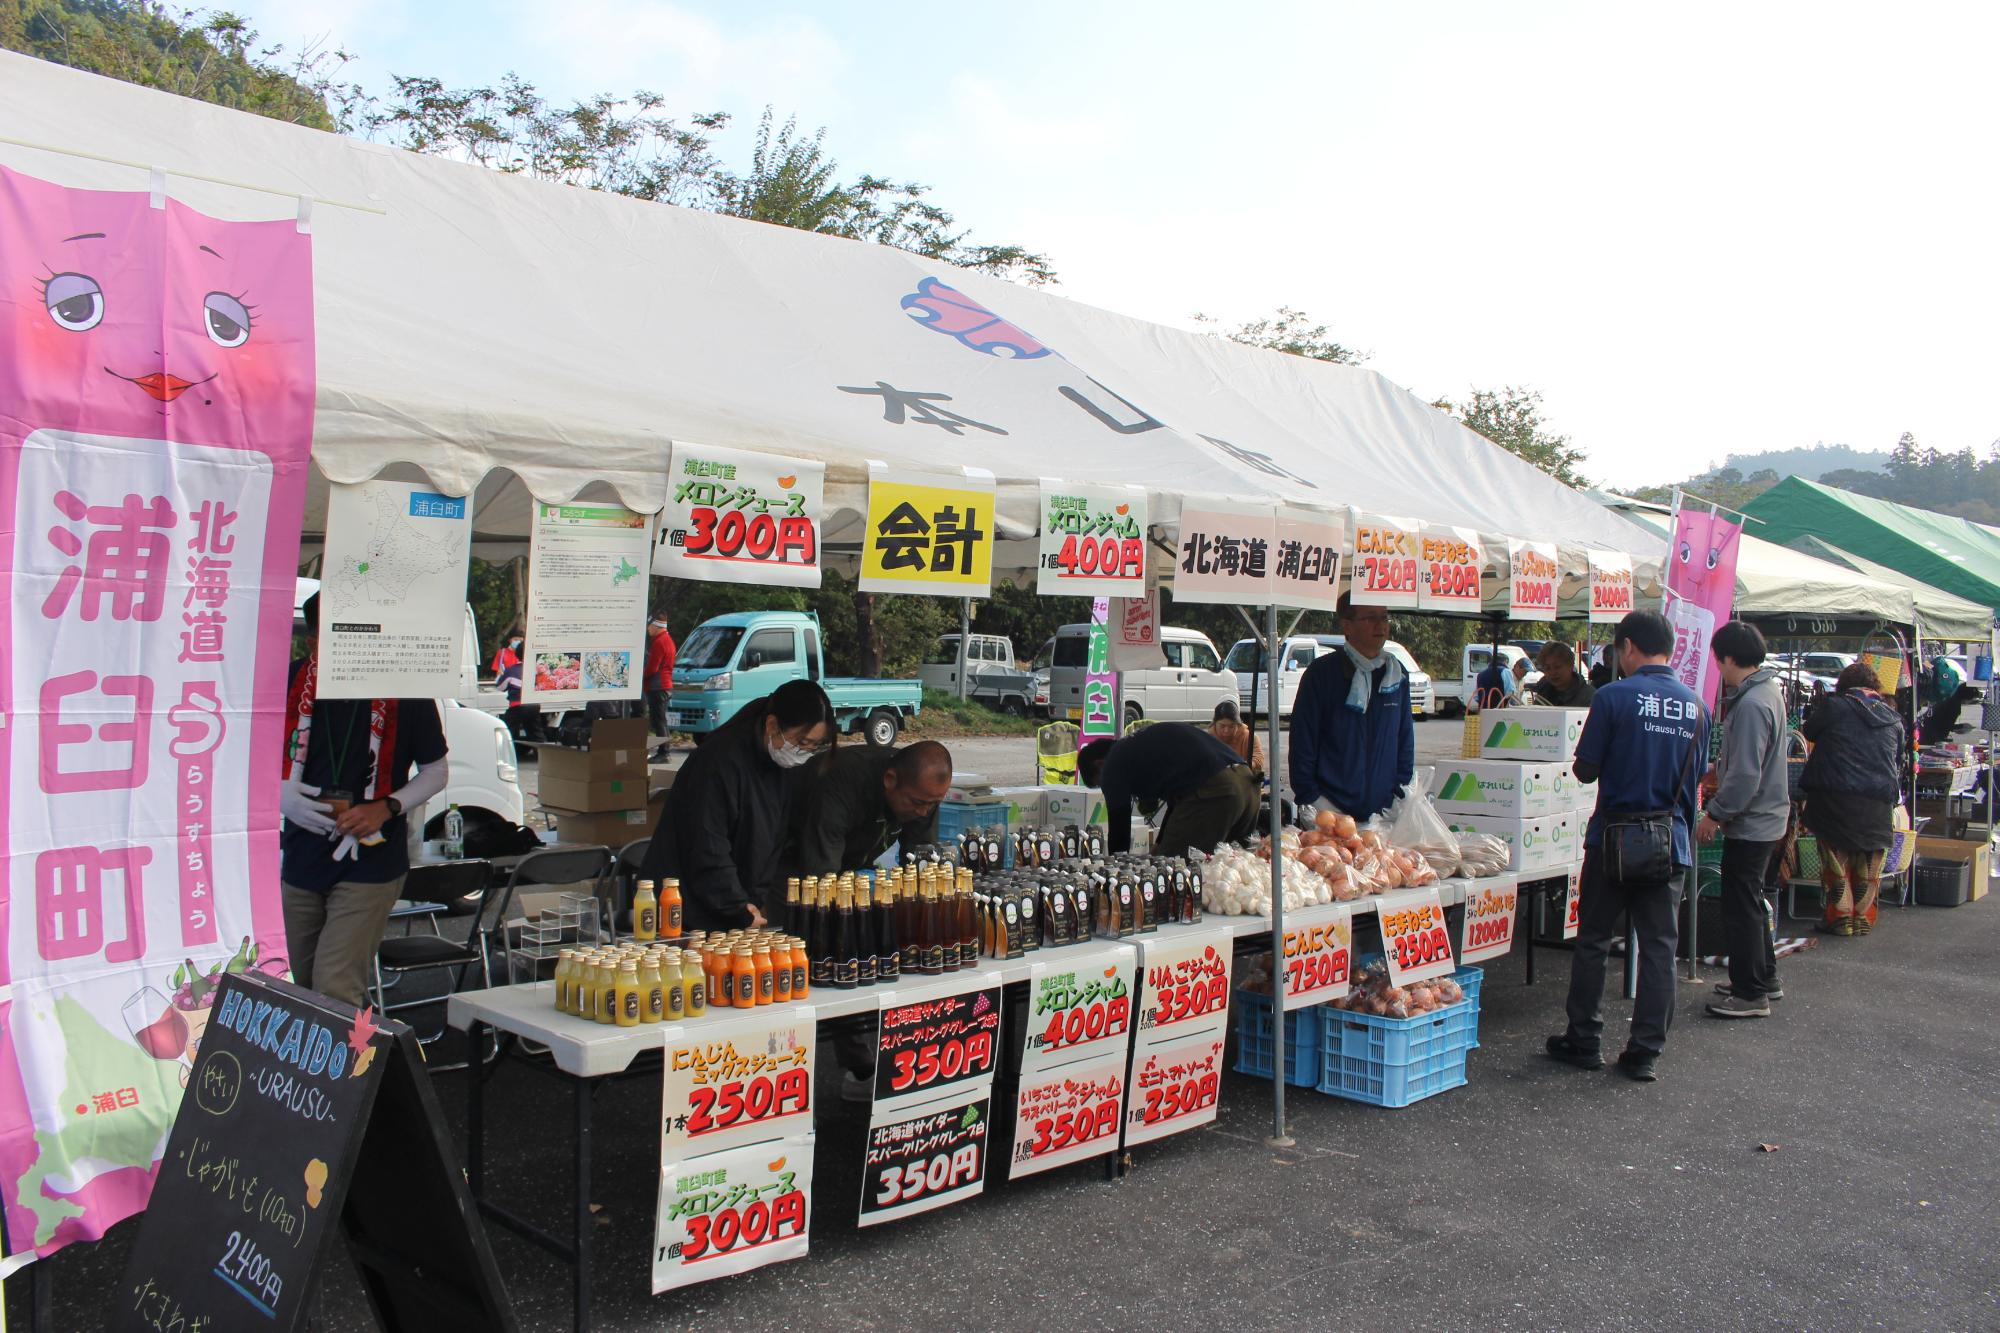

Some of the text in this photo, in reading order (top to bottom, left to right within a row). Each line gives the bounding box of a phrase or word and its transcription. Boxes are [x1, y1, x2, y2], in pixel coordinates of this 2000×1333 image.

[684, 458, 736, 480] 浦臼町産
[414, 500, 460, 517] 浦臼町
[673, 480, 806, 517] メロンジュース
[659, 508, 816, 565] 1個 300円
[875, 502, 983, 574] 会計
[1047, 509, 1141, 539] メロンジャム
[1356, 527, 1405, 556] にんにく
[1057, 534, 1143, 576] 400円
[1182, 533, 1339, 585] 北海道 浦臼町
[1422, 537, 1469, 565] たまねぎ
[178, 500, 237, 664] 北海道
[1365, 557, 1417, 590] 750円
[1430, 562, 1480, 596] 250円
[1516, 581, 1552, 605] 1200円
[1593, 586, 1630, 608] 2400円
[36, 489, 177, 963] 浦臼町
[1644, 722, 1695, 740] Urausu Tow
[1382, 905, 1433, 938] たまねぎ
[1468, 916, 1509, 947] 1200円
[1282, 923, 1336, 959] にんにく
[1394, 926, 1451, 969] 250円
[1149, 953, 1226, 990] りんごジャム
[1288, 947, 1349, 993] 750円
[884, 997, 966, 1029] 北海道サイダー
[1036, 975, 1128, 1016] メロンジャム
[1155, 975, 1228, 1023] 350円
[217, 988, 348, 1080] HOKKAIDO
[1043, 995, 1130, 1049] 400円
[671, 1040, 739, 1072] にんじん
[692, 1046, 807, 1084] ミックスジュース
[891, 1030, 992, 1091] 350円
[92, 1087, 140, 1115] 浦臼
[665, 1067, 809, 1134] 1本 250円
[1020, 1075, 1122, 1105] いちごと ジャム
[1144, 1071, 1218, 1125] 250円
[874, 1112, 958, 1146] 北海道サイダー
[1031, 1098, 1119, 1155] 350円
[676, 1168, 727, 1194] 浦臼町産
[876, 1143, 980, 1207] 350円
[667, 1171, 797, 1221] メロンジュース
[680, 1189, 806, 1260] 300円
